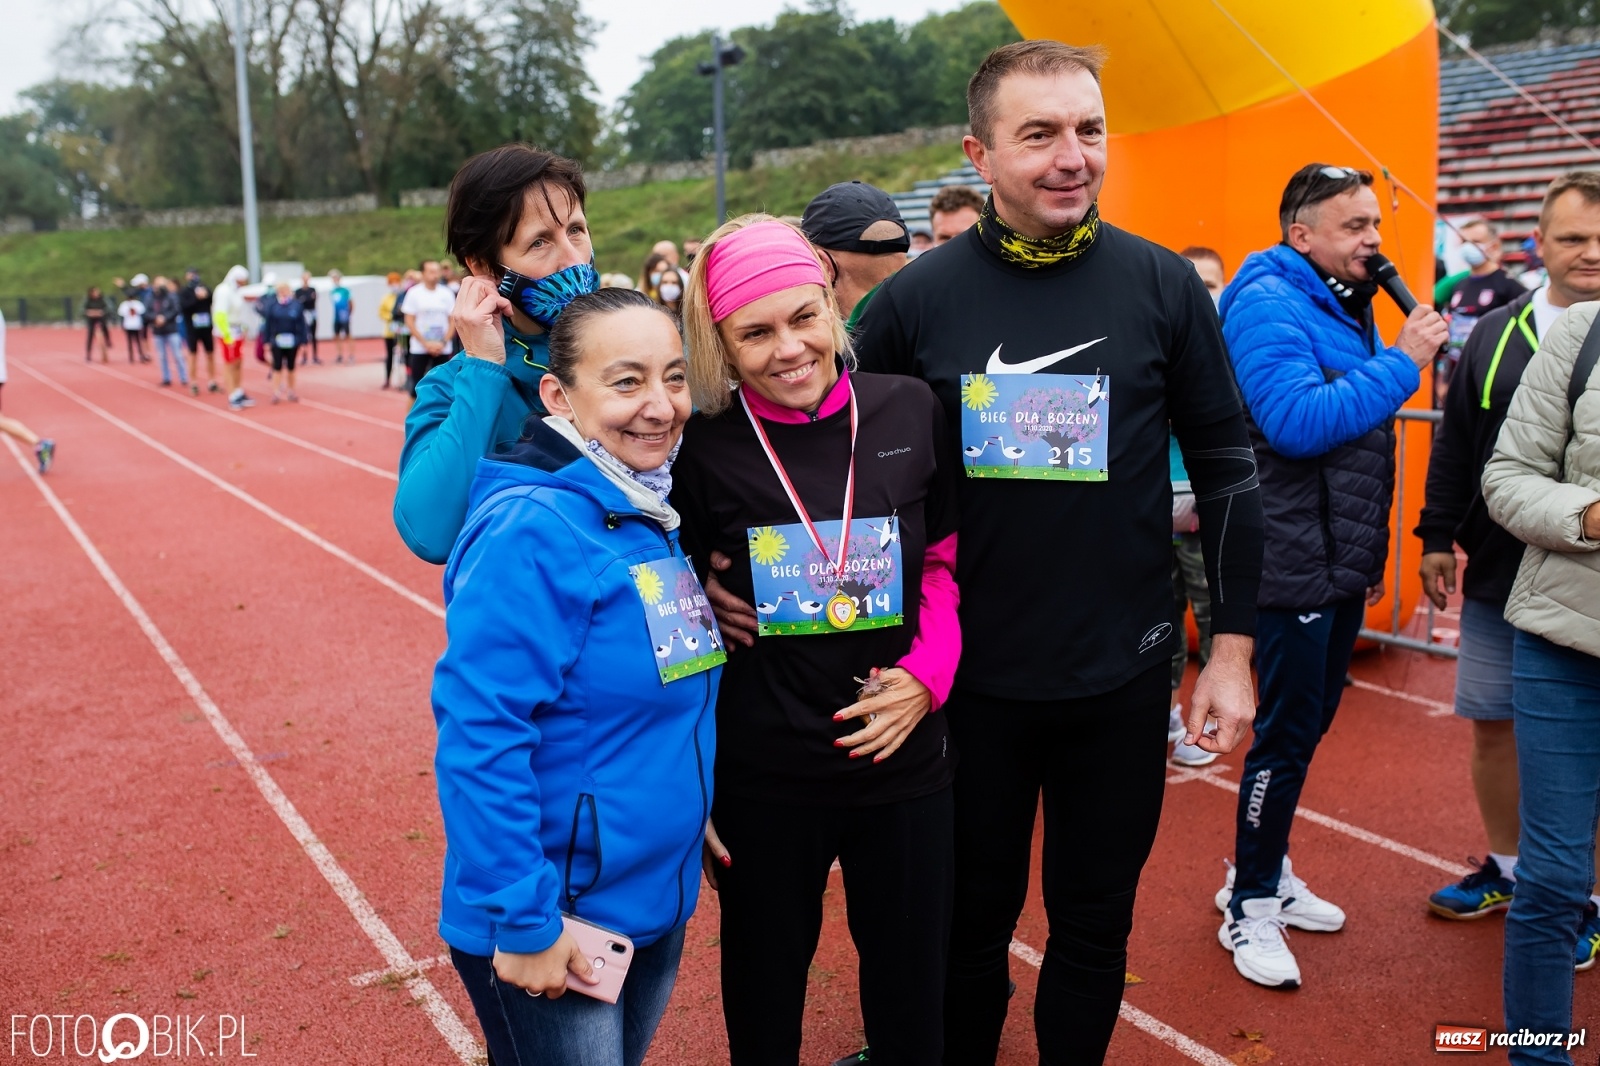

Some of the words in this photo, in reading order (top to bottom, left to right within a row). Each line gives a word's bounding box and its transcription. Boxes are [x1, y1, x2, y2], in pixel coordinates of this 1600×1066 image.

[980, 411, 1007, 424] BIEG
[1015, 411, 1040, 424] DLA
[1047, 410, 1099, 425] BOŻENY
[1047, 446, 1092, 466] 215
[771, 564, 801, 578] BIEG
[810, 561, 835, 576] DLA
[657, 601, 677, 618] BIEG
[679, 596, 694, 612] DLA
